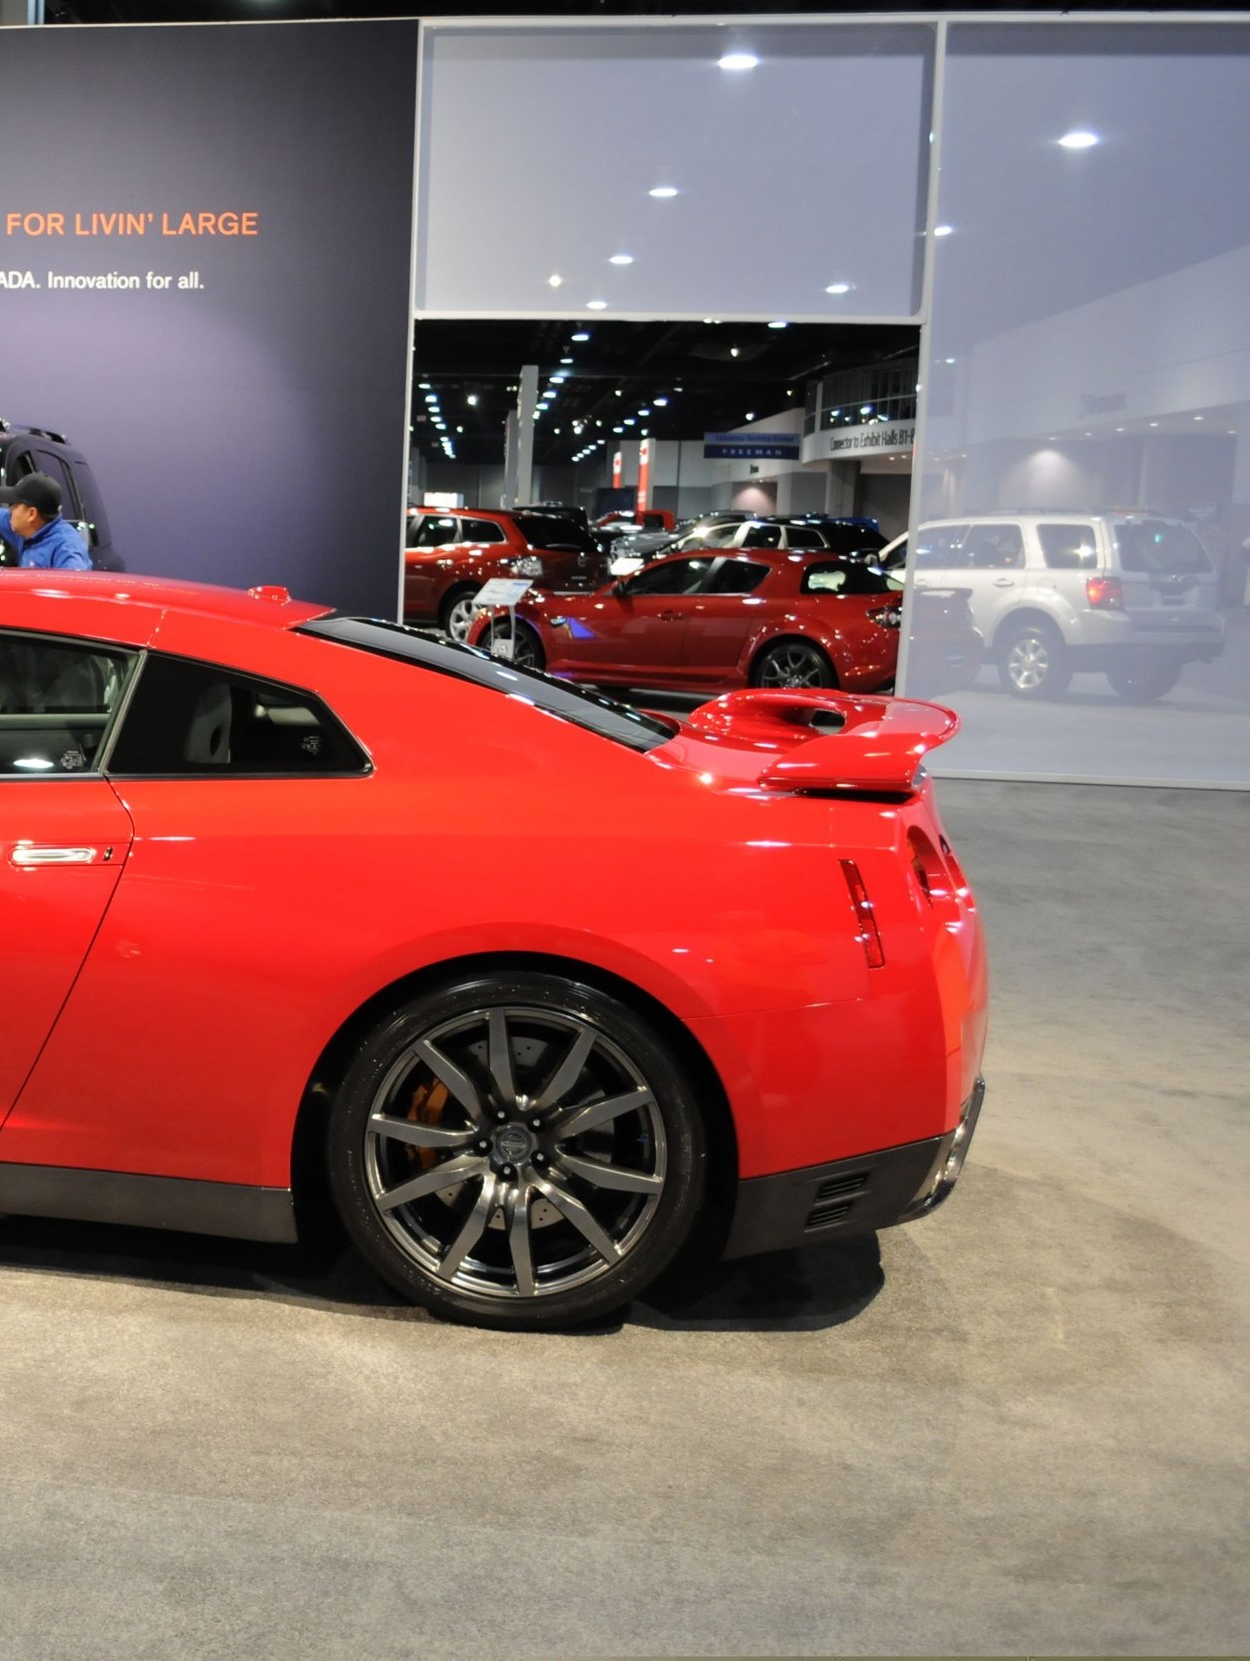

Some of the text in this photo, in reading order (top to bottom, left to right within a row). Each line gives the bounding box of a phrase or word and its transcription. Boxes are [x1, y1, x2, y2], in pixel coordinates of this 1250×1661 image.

[7, 213, 65, 236] FOR
[75, 212, 154, 236] LIVIN'
[162, 211, 259, 235] LARGE
[48, 271, 140, 289] Innovation
[146, 271, 172, 289] for
[178, 271, 204, 289] all.
[860, 432, 881, 448] Exhibit
[882, 429, 898, 446] Halls
[722, 448, 782, 456] FREEMAN
